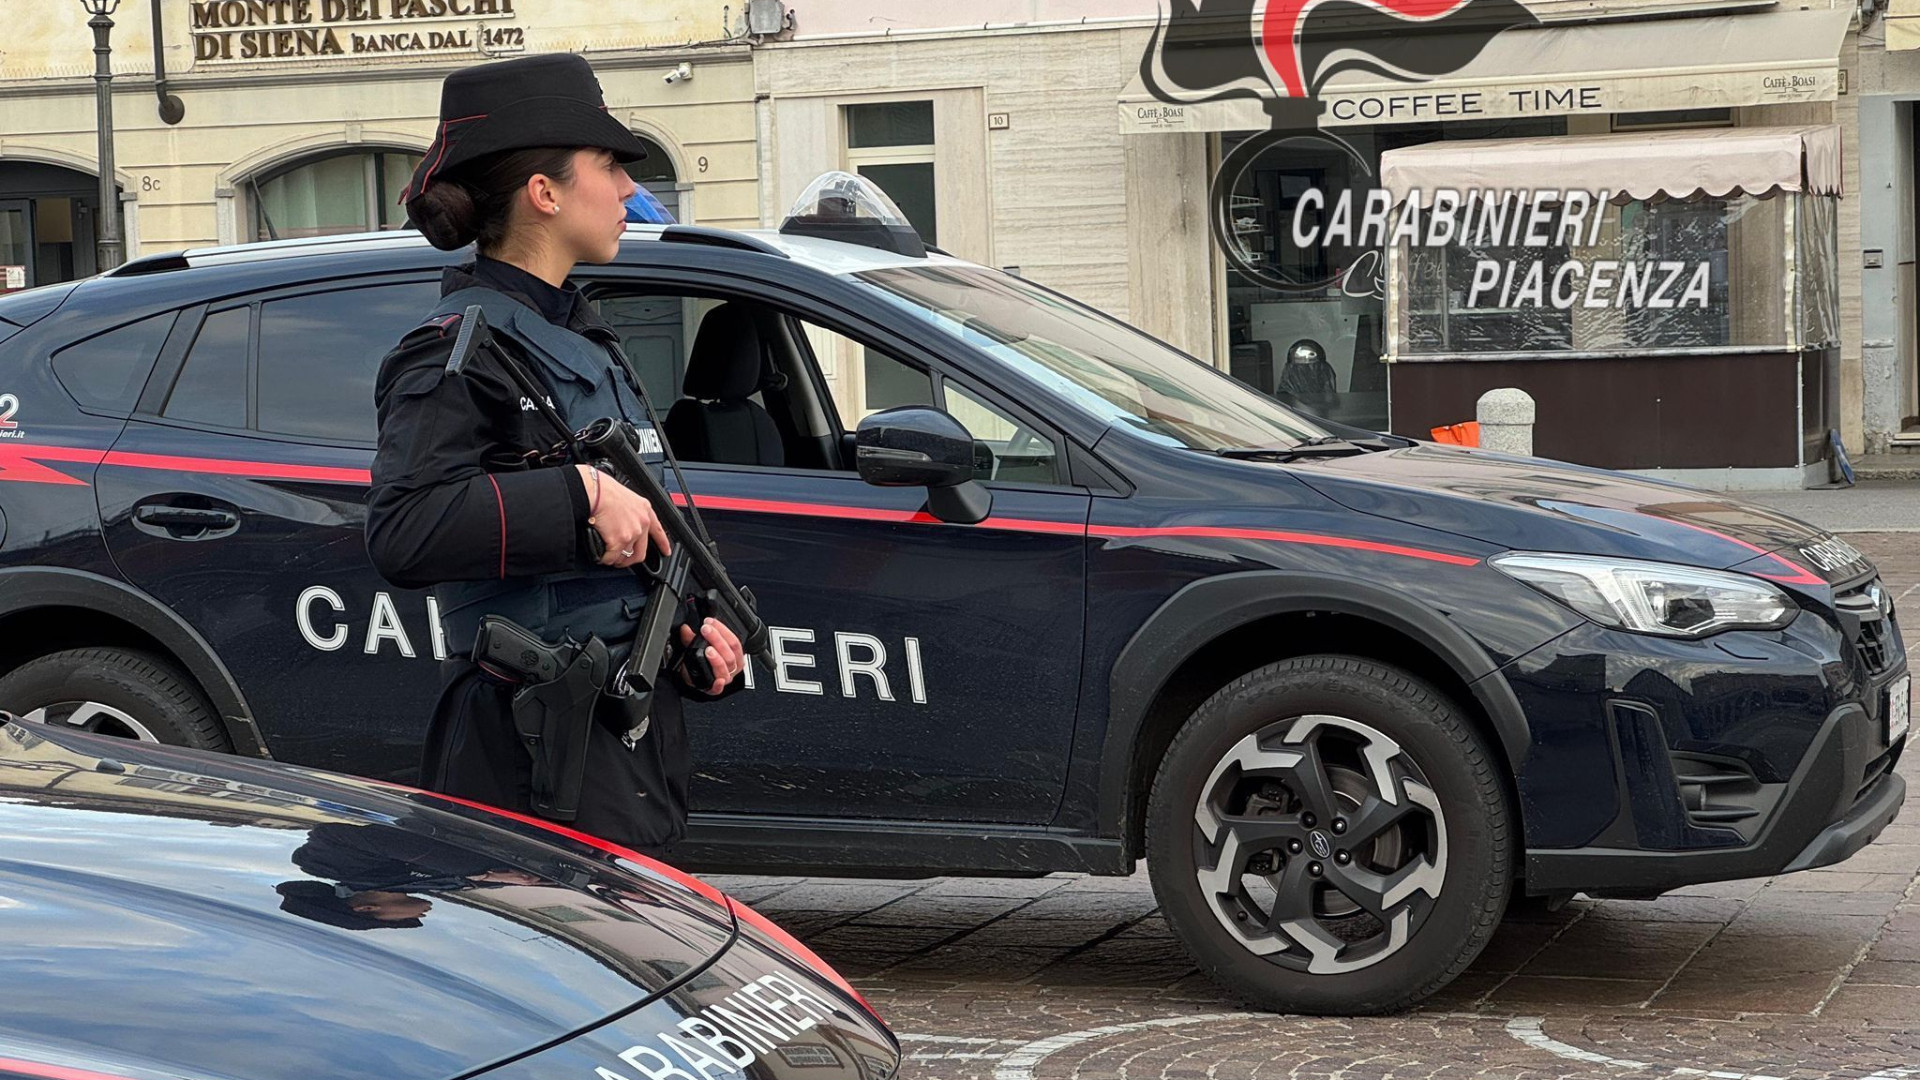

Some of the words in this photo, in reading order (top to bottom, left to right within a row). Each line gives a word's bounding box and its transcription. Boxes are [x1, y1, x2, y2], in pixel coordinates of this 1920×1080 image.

[190, 0, 313, 28] MONTE
[321, 0, 382, 22] DEI
[195, 33, 233, 60] DI
[240, 27, 345, 58] SIENA
[352, 32, 426, 52] BANCA
[428, 30, 473, 48] DAL
[483, 27, 524, 46] 1472
[1332, 93, 1483, 120] COFFEE
[1508, 87, 1602, 111] TIME
[993, 116, 1004, 126] 10
[697, 156, 709, 173] 9
[594, 970, 839, 1080] RABINIERI
